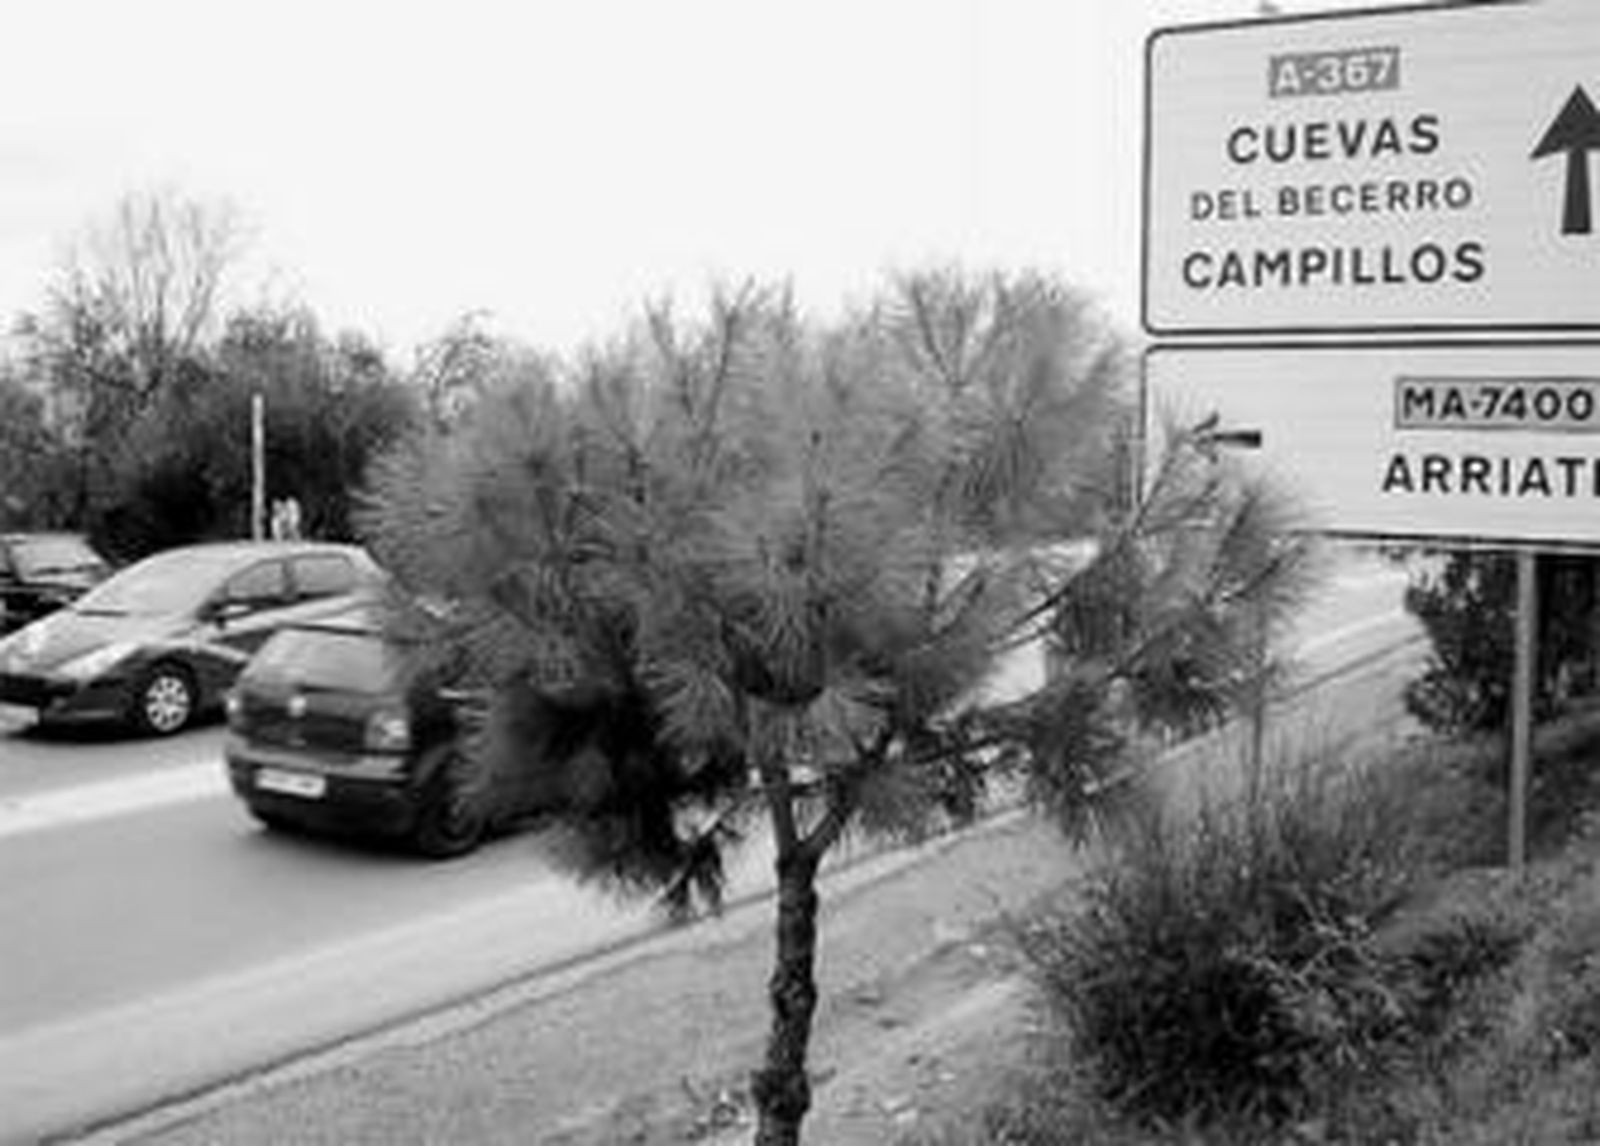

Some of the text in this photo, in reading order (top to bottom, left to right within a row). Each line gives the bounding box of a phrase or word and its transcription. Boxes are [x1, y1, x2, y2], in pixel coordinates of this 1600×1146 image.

[1274, 54, 1394, 93] A-367
[1227, 114, 1440, 164] CUEVAS
[1191, 178, 1473, 221] DEL BECERRO
[1182, 242, 1486, 288] CAMPILLOS
[1402, 387, 1596, 420] MA-7400
[1382, 454, 1600, 497] ARRIAT
